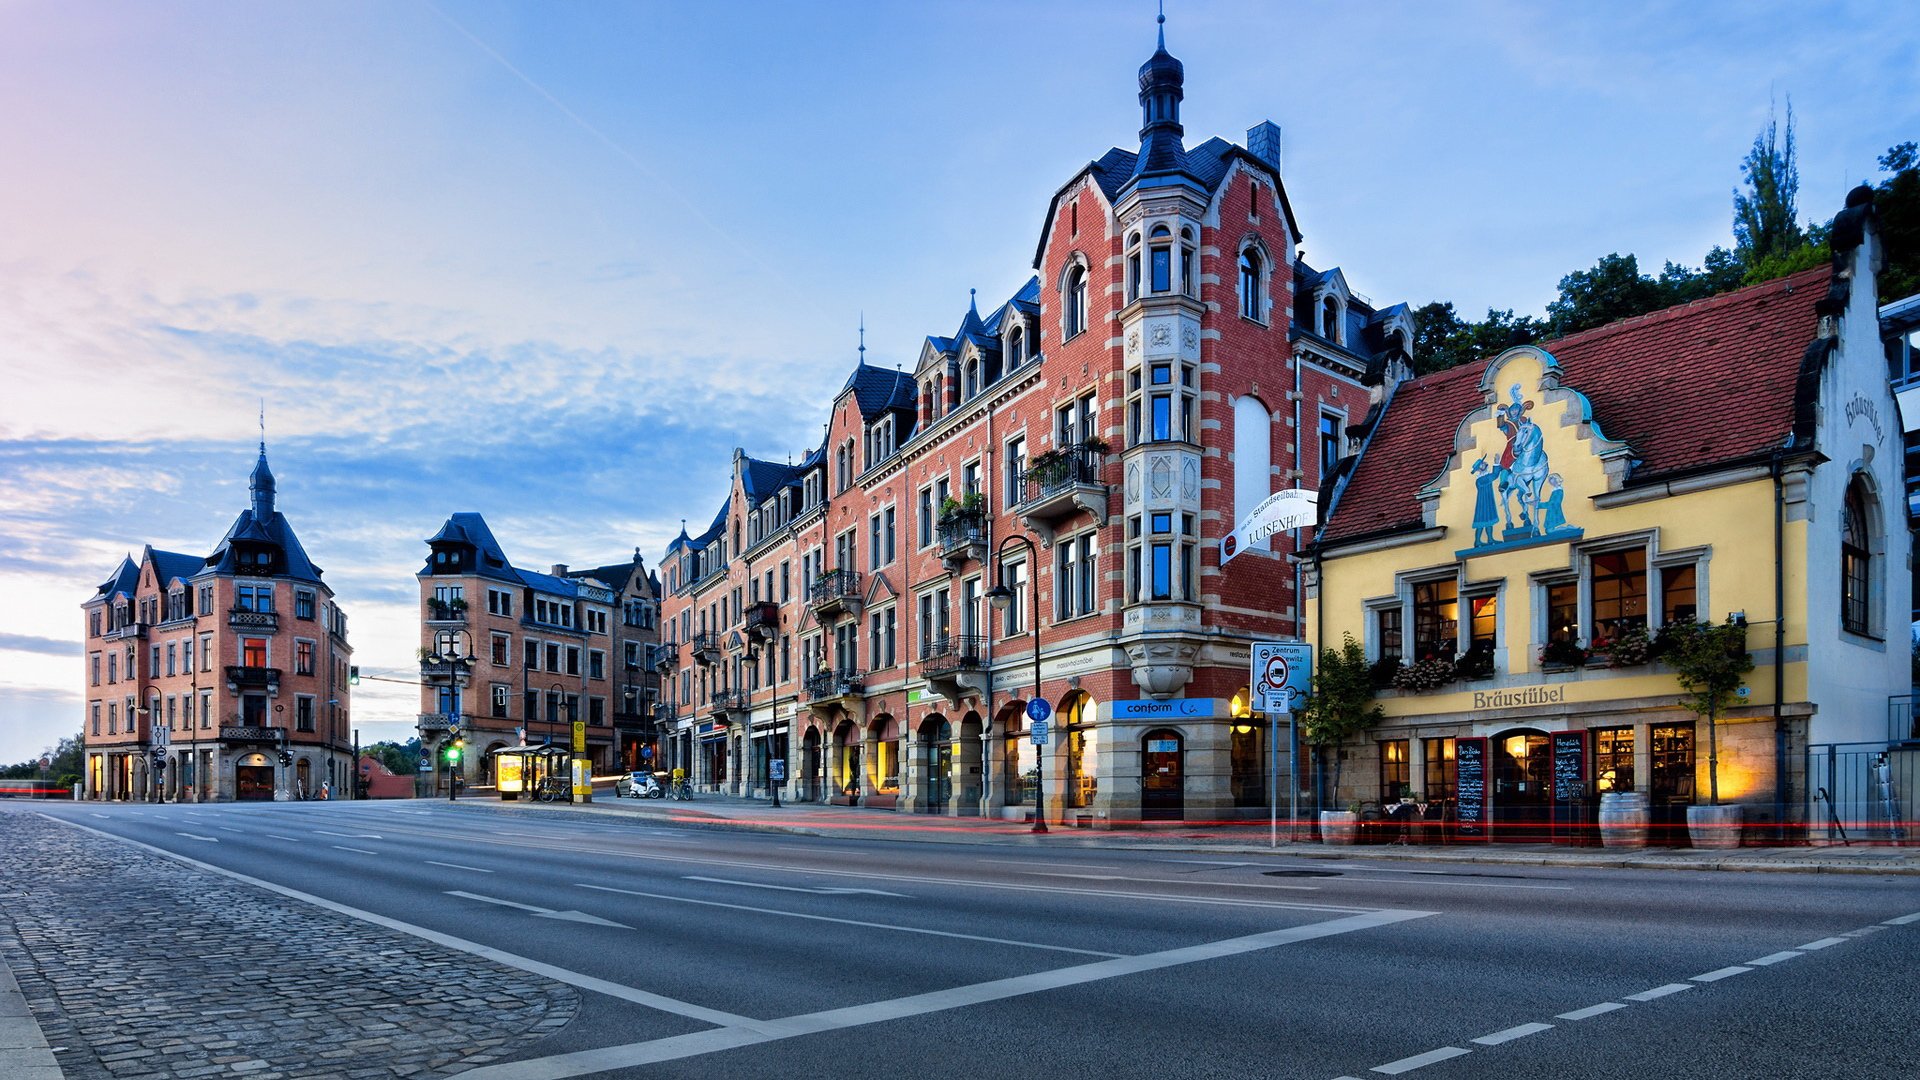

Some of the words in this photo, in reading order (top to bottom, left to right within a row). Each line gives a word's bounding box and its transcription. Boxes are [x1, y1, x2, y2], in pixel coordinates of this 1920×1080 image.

[1845, 391, 1885, 447] Bräustübel
[1253, 489, 1304, 518] Standseilbahn
[1249, 512, 1308, 545] LUISENHOF
[1272, 646, 1300, 654] Zentrum
[1127, 703, 1172, 713] conform
[1474, 685, 1564, 709] Bräustübel
